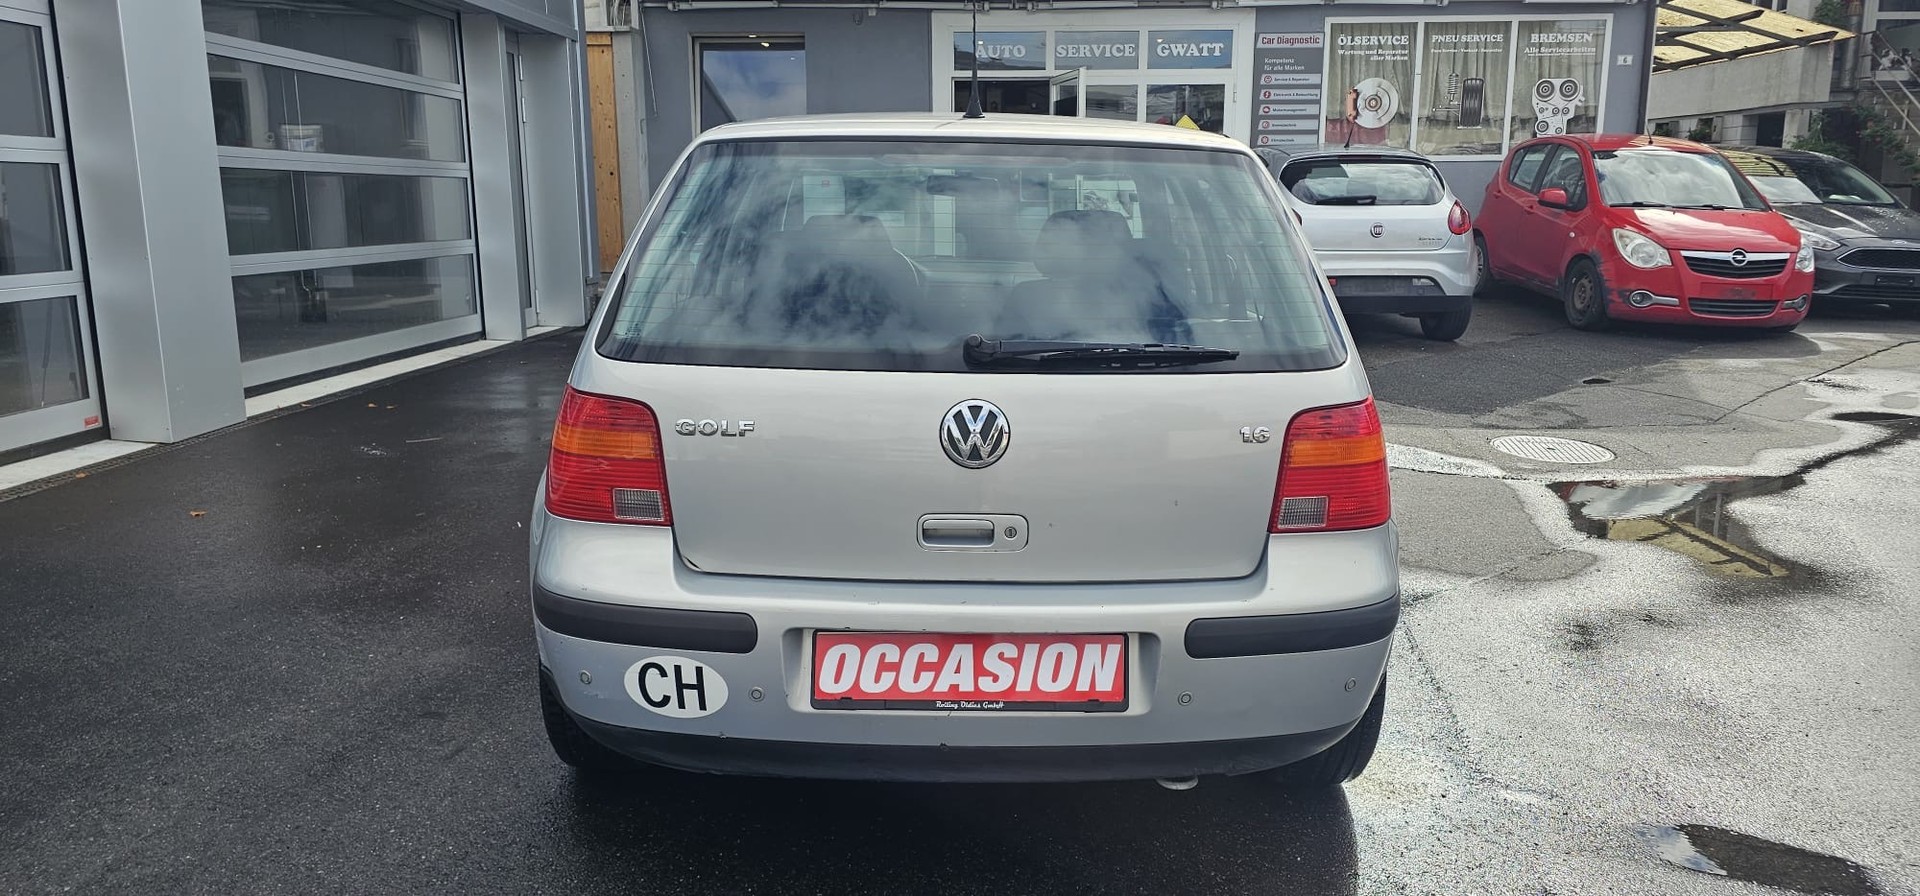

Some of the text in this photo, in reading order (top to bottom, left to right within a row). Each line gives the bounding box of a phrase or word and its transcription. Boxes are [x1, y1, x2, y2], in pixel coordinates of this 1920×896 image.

[1261, 35, 1320, 46] Car Diagnostic
[1337, 34, 1409, 46] ÖLSERVICE
[1432, 34, 1504, 43] PNEU SERVICE
[1530, 33, 1594, 43] BREMSEN
[975, 43, 1224, 58] AUTO SERVICE GWATT
[675, 418, 756, 438] GOLF
[818, 643, 1122, 694] OCCASION
[638, 661, 708, 711] CH
[936, 701, 959, 710] Rolling
[983, 700, 1005, 709] GmbH
